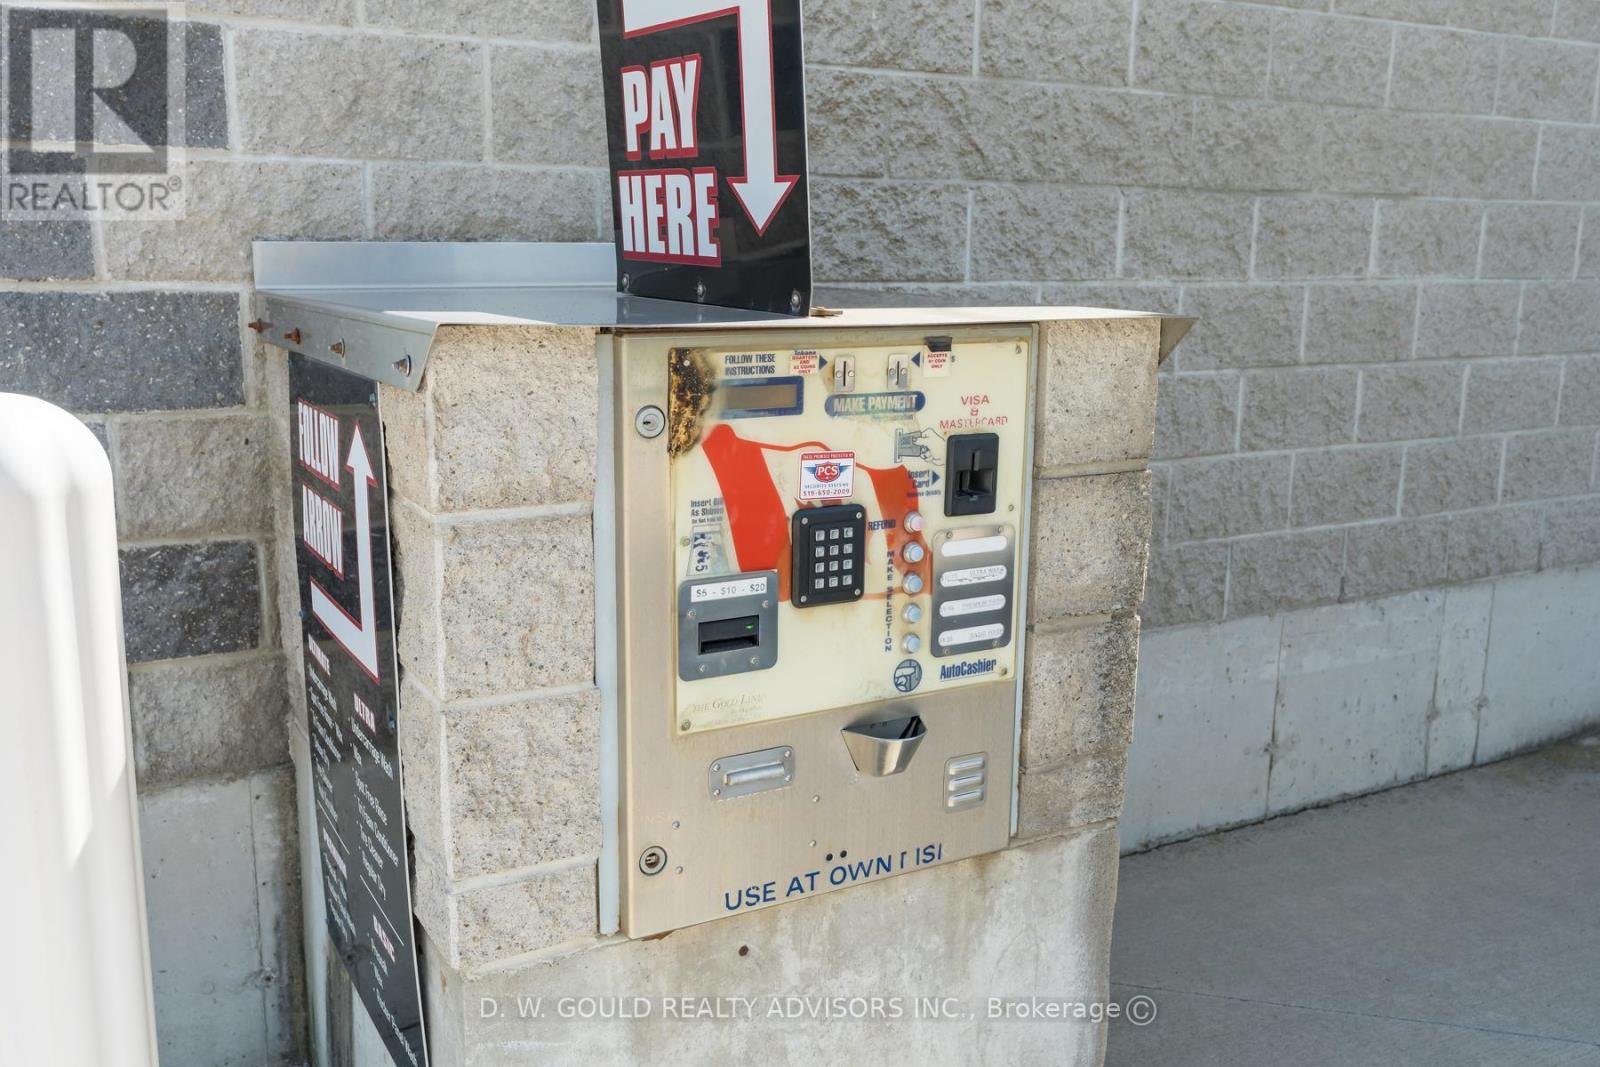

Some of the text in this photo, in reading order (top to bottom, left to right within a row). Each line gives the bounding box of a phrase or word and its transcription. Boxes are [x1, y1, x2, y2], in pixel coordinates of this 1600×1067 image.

[621, 55, 700, 158] PAY
[617, 168, 720, 265] HERE
[725, 353, 776, 364] FOLLOW THESE
[725, 365, 776, 376] INSTRUCTIONS
[833, 394, 918, 413] MAKE PAYMENT
[960, 395, 990, 406] VISA
[298, 399, 340, 490] FOLLOW
[817, 465, 838, 476] PCS
[908, 469, 930, 479] Insert
[912, 479, 930, 488] Card
[691, 499, 712, 508] Insert
[691, 509, 700, 517] As
[302, 483, 344, 580] ARROW
[868, 520, 896, 530] REFUND
[886, 551, 895, 581] MAKE
[696, 589, 708, 598] $5
[721, 586, 737, 596] $10
[749, 583, 766, 593] $20
[884, 586, 894, 652] SELECTION
[940, 659, 997, 680] AutoCashier
[354, 692, 377, 735] ULTRA
[725, 881, 777, 911] USE
[785, 871, 821, 897] AT
[829, 854, 892, 886] OWN
